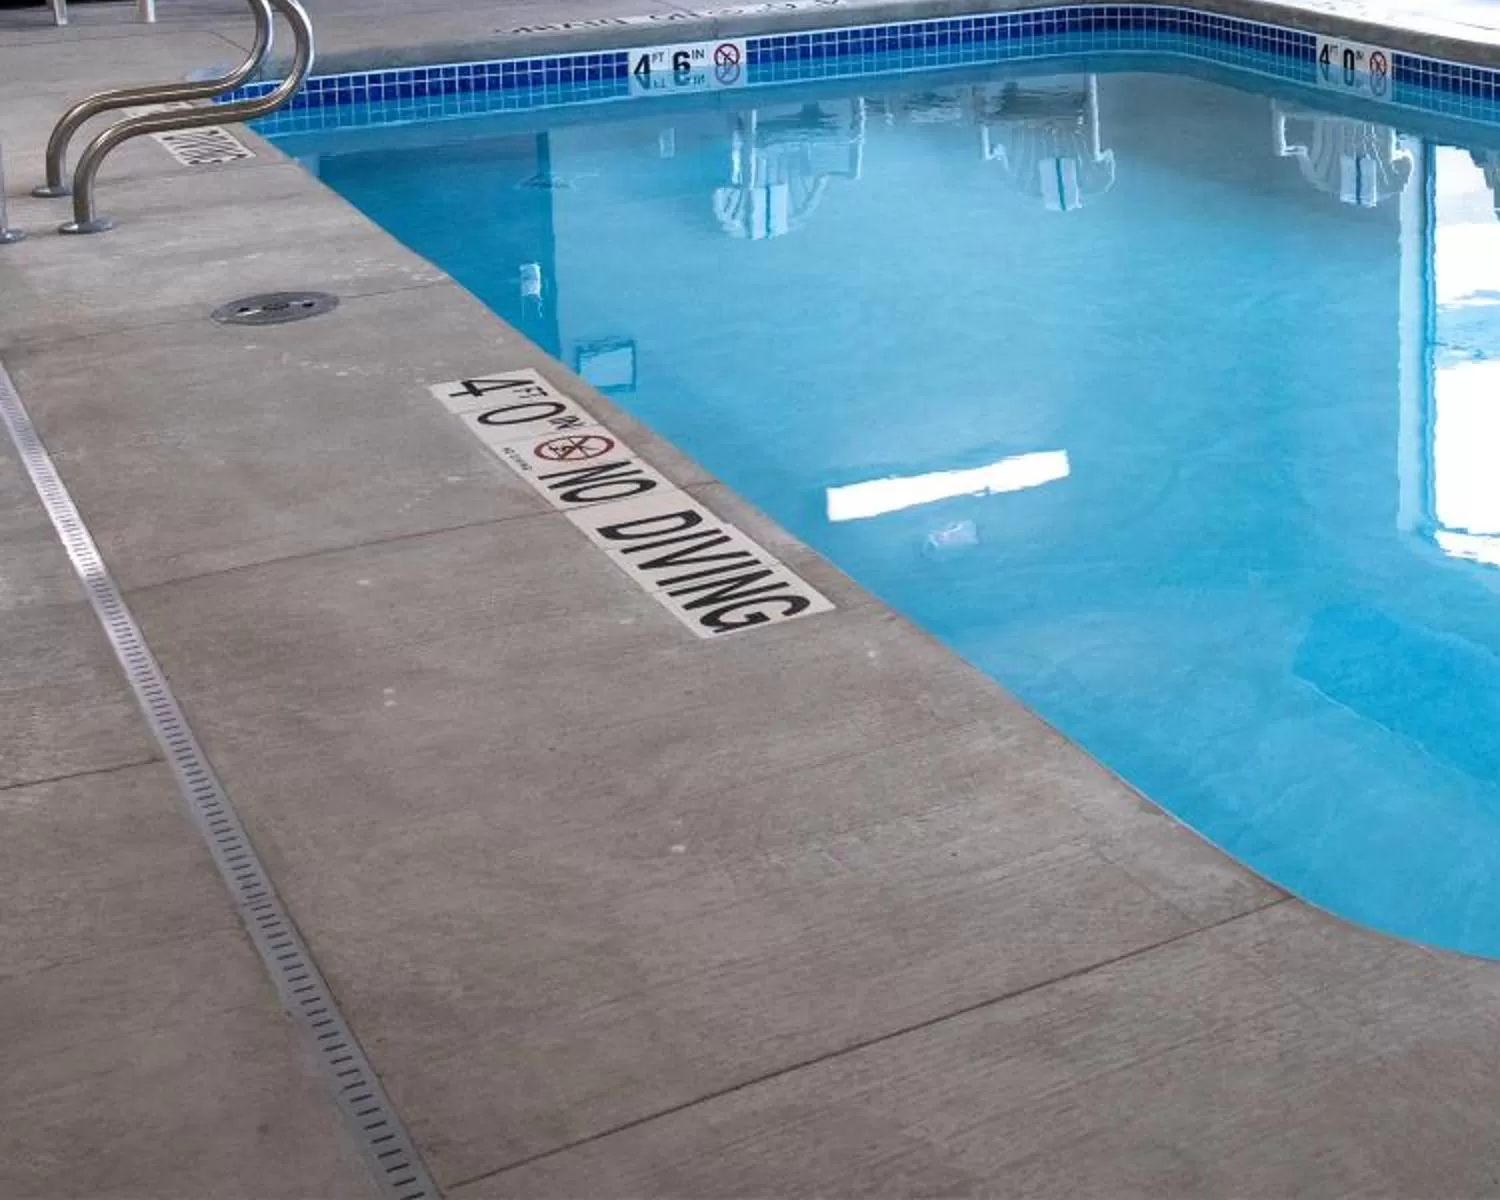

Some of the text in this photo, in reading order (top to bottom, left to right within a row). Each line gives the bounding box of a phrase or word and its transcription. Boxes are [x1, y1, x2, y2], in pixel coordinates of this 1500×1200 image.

[634, 53, 650, 74] 4
[673, 50, 690, 74] 6
[691, 48, 704, 60] IN
[1319, 43, 1330, 65] 4
[1343, 47, 1355, 71] 0
[448, 379, 535, 398] 4
[477, 401, 567, 426] 0
[536, 460, 811, 634] NO DIVING
